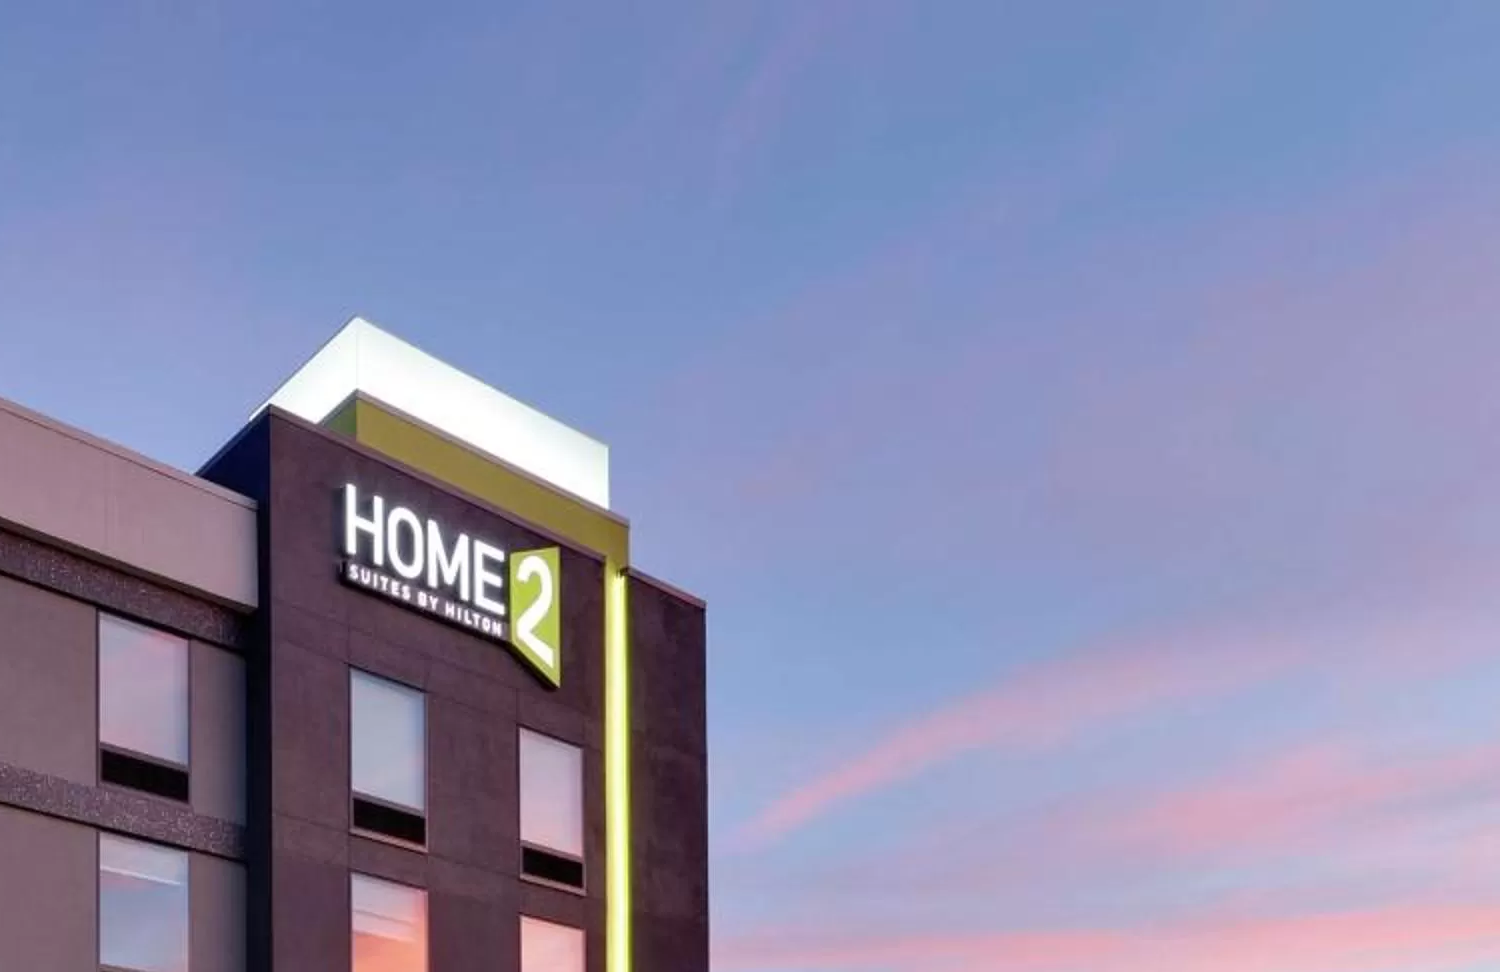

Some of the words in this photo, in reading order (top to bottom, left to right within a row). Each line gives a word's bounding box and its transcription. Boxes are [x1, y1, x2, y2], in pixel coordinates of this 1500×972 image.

[345, 484, 505, 616] HOME
[349, 564, 411, 600] SUITES
[418, 592, 439, 611] BY
[445, 604, 502, 637] HILTON
